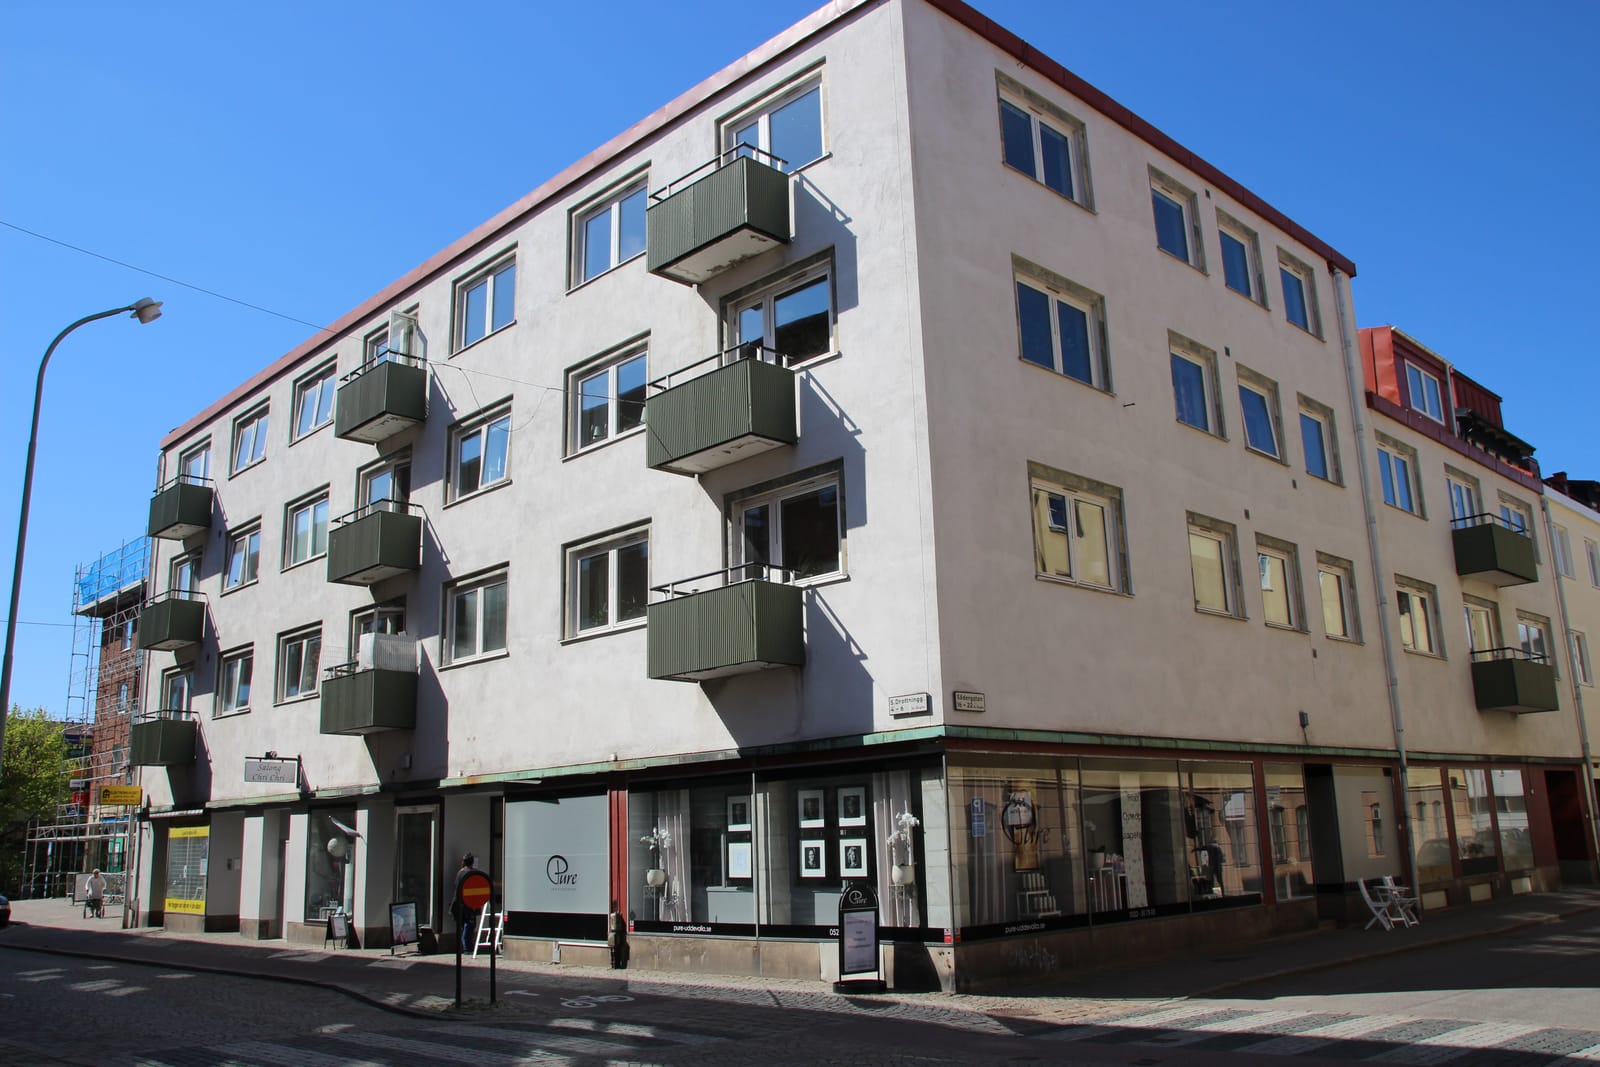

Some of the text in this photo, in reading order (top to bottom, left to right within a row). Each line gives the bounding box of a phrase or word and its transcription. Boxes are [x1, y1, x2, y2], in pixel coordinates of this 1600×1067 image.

[956, 694, 983, 703] Södergatan
[257, 763, 282, 775] Salong
[546, 854, 578, 885] Pure
[849, 890, 868, 905] Pure
[673, 925, 712, 933] pure-uddevalla.se
[829, 928, 840, 936] 052
